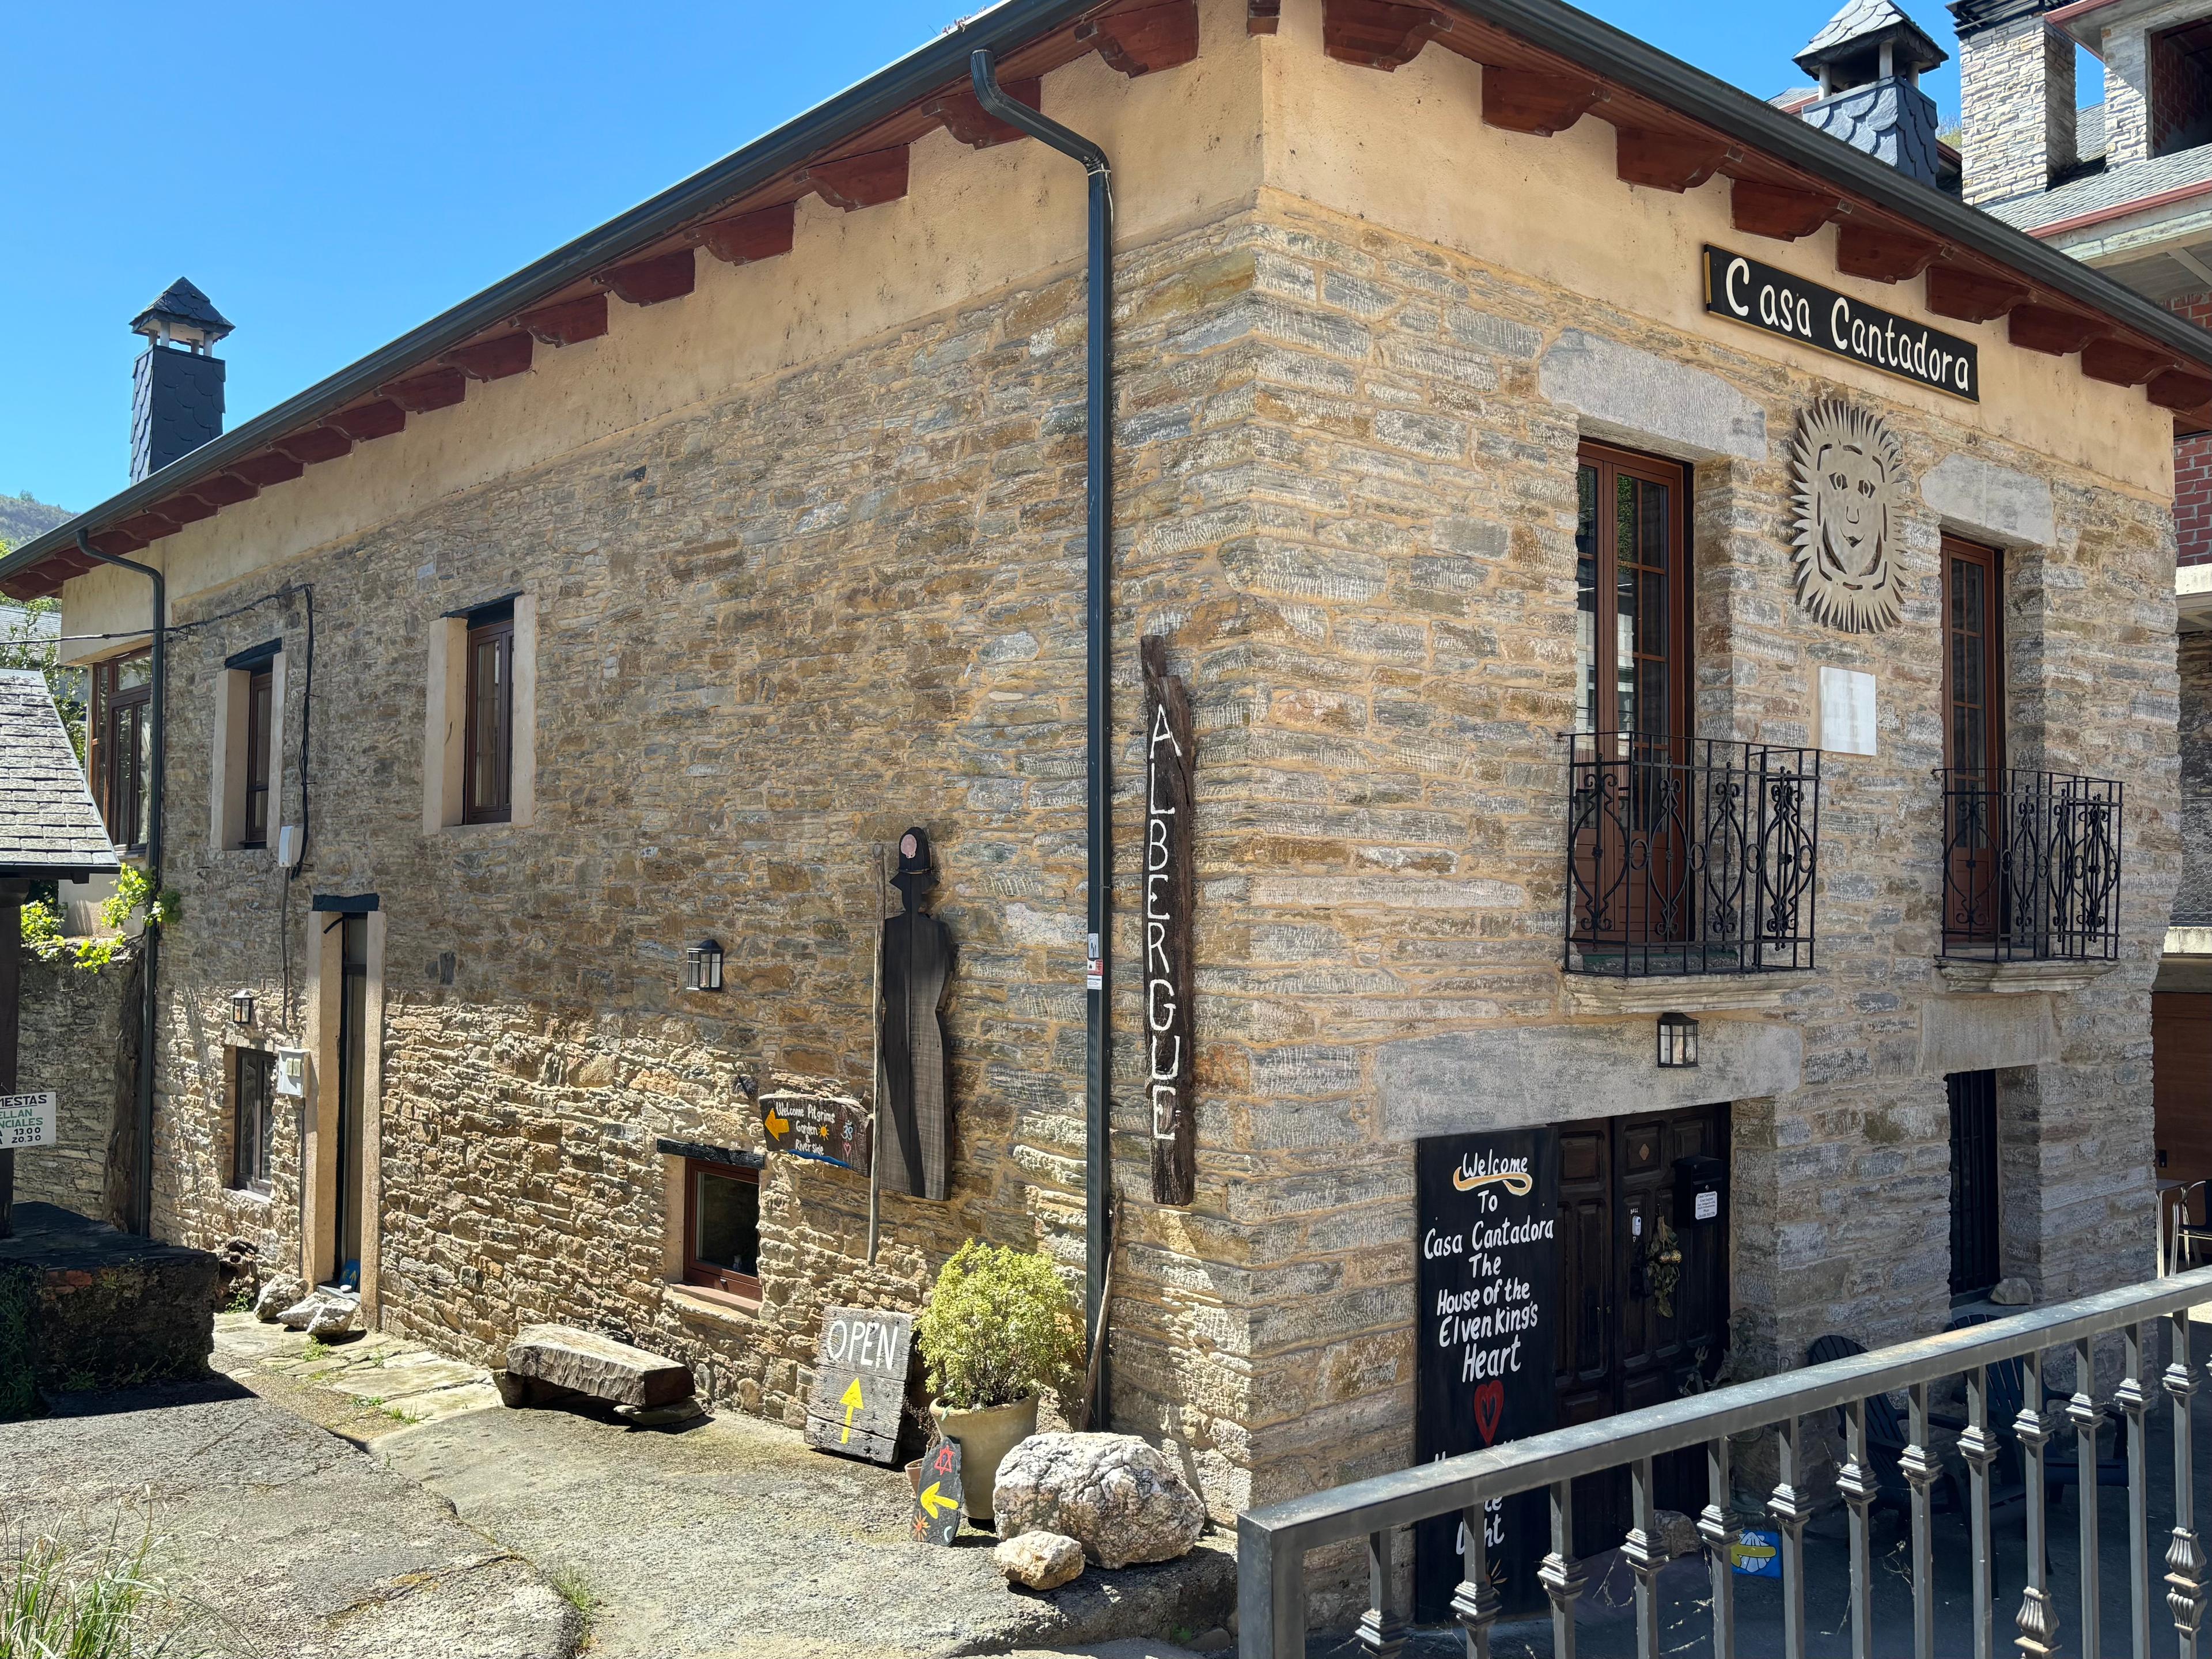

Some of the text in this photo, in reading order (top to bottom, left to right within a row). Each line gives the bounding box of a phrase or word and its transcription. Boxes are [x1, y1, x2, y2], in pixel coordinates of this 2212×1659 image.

[1726, 257, 1969, 392] Casa Cantadora
[1148, 704, 1181, 1140] ALBERGUE
[776, 1101, 835, 1124] Welcome Pilgrims
[796, 1120, 818, 1136] Garden
[805, 1134, 810, 1143] &
[1462, 1148, 1528, 1177] Welcome
[1478, 1190, 1498, 1214] To
[1424, 1215, 1555, 1260] Casa Cantadora
[1468, 1252, 1501, 1278] The
[1437, 1277, 1531, 1316] House of the
[827, 1319, 899, 1371] OPEN
[1438, 1314, 1492, 1348] Elven
[1462, 1334, 1521, 1382] Heart
[1456, 1513, 1505, 1555] Lht
